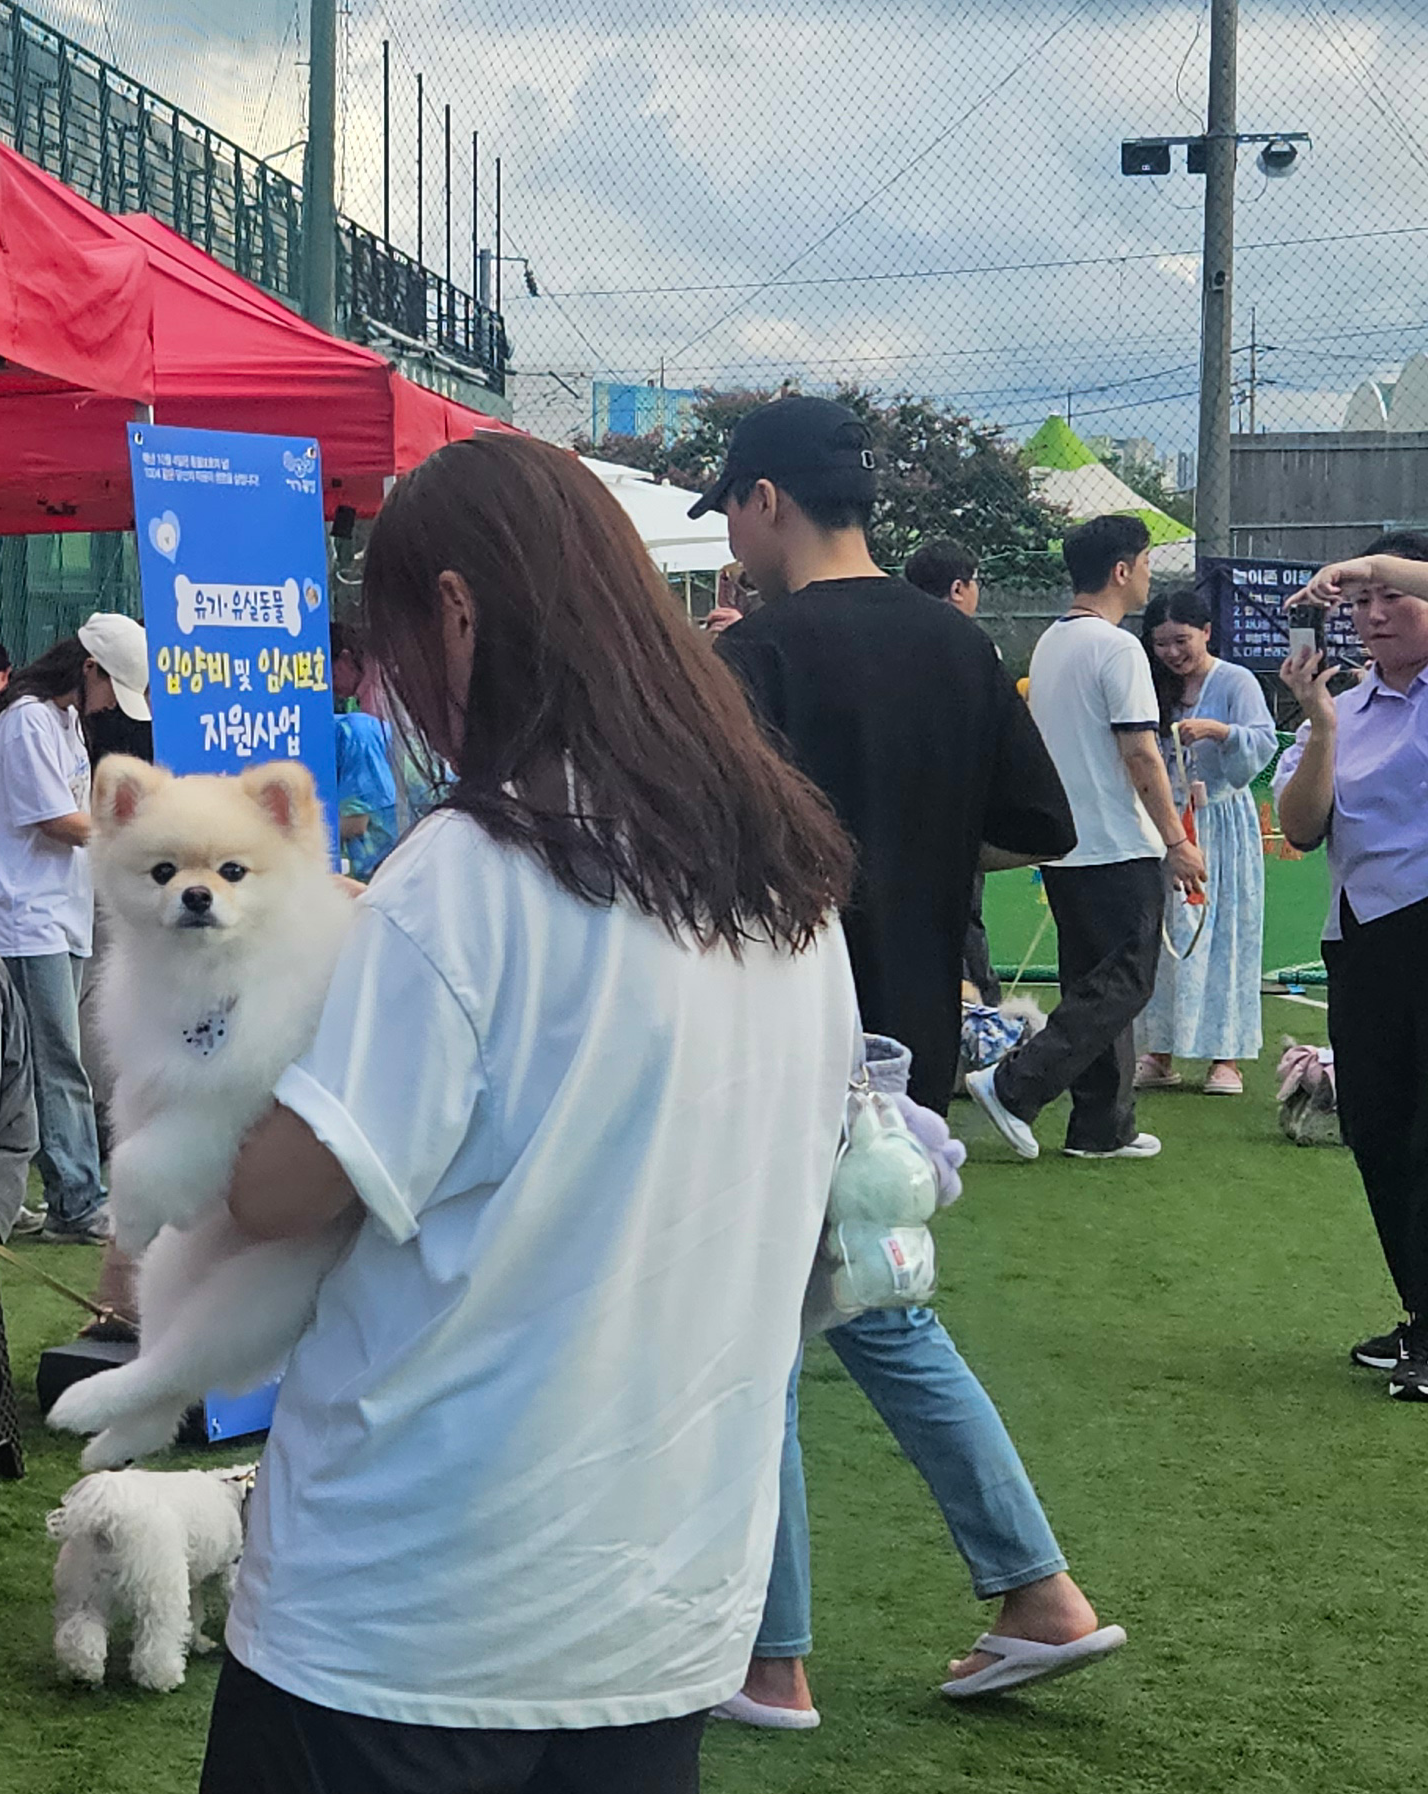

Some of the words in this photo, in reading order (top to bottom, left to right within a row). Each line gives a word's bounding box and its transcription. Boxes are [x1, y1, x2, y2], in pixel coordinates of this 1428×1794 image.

[157, 646, 231, 695] 입양비
[234, 657, 253, 692] 및
[257, 646, 329, 694] 임시보호
[199, 703, 302, 757] 지원사업
